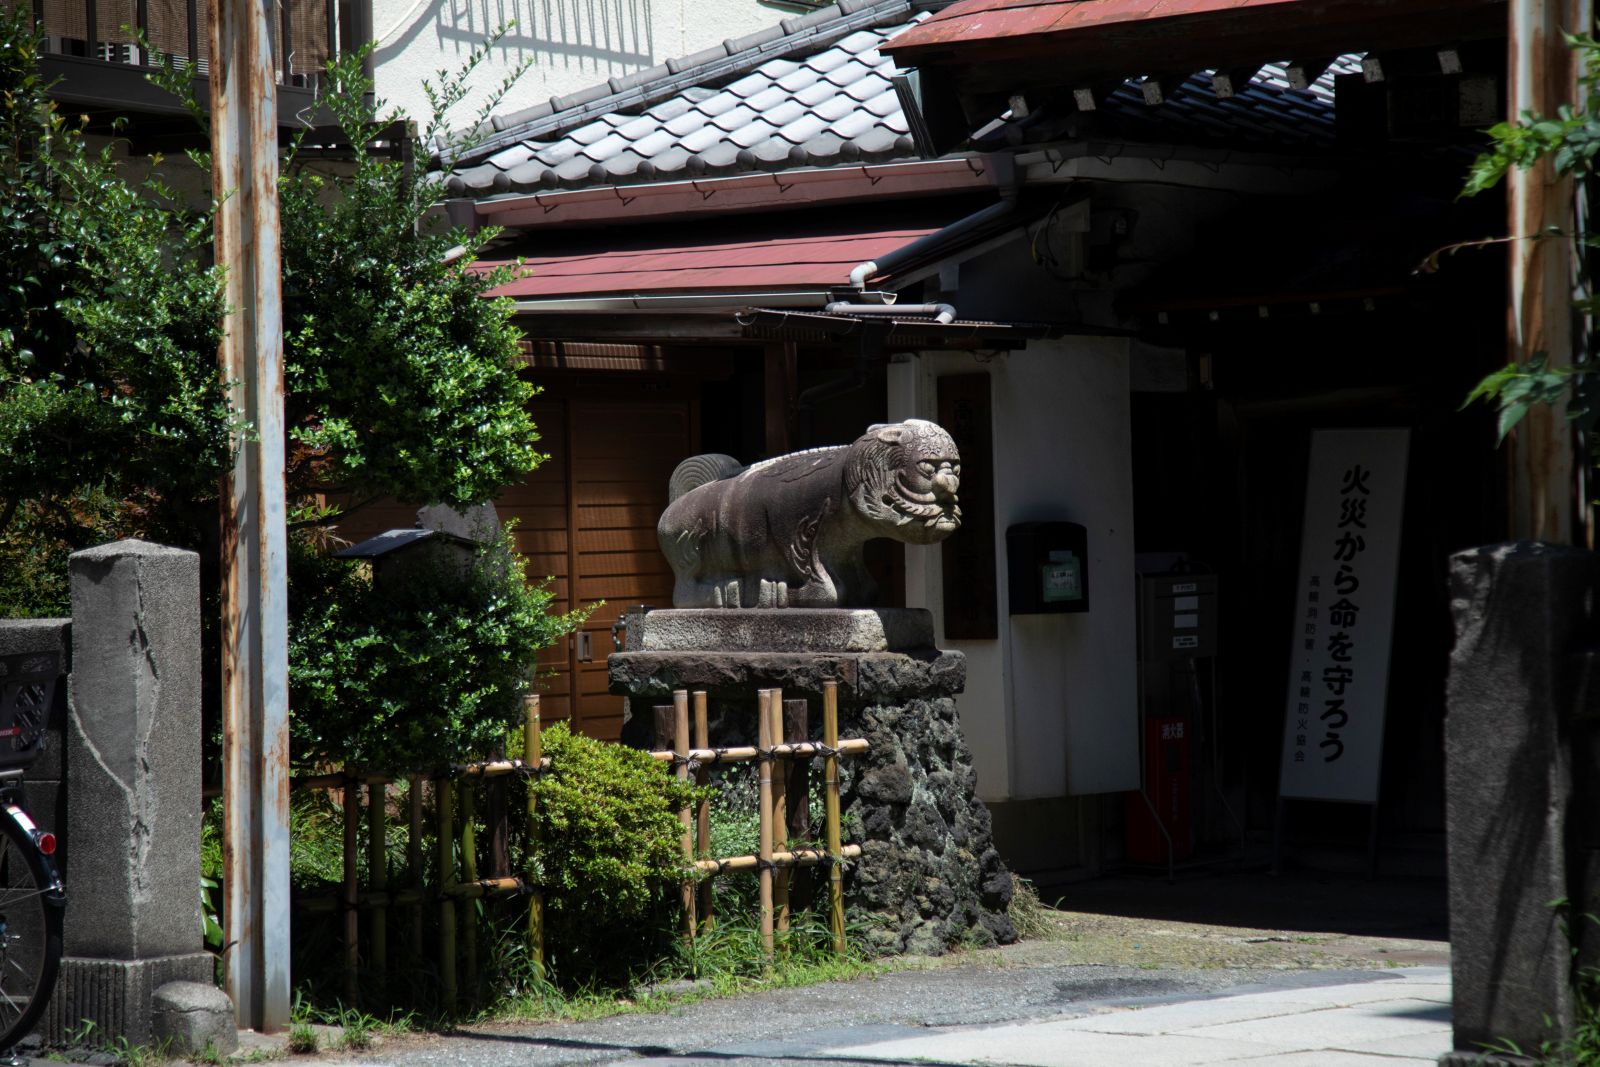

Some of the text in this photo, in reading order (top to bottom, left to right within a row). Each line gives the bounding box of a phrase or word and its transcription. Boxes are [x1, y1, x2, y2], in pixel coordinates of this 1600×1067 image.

[1319, 465, 1370, 763] 火災から命を守ろう
